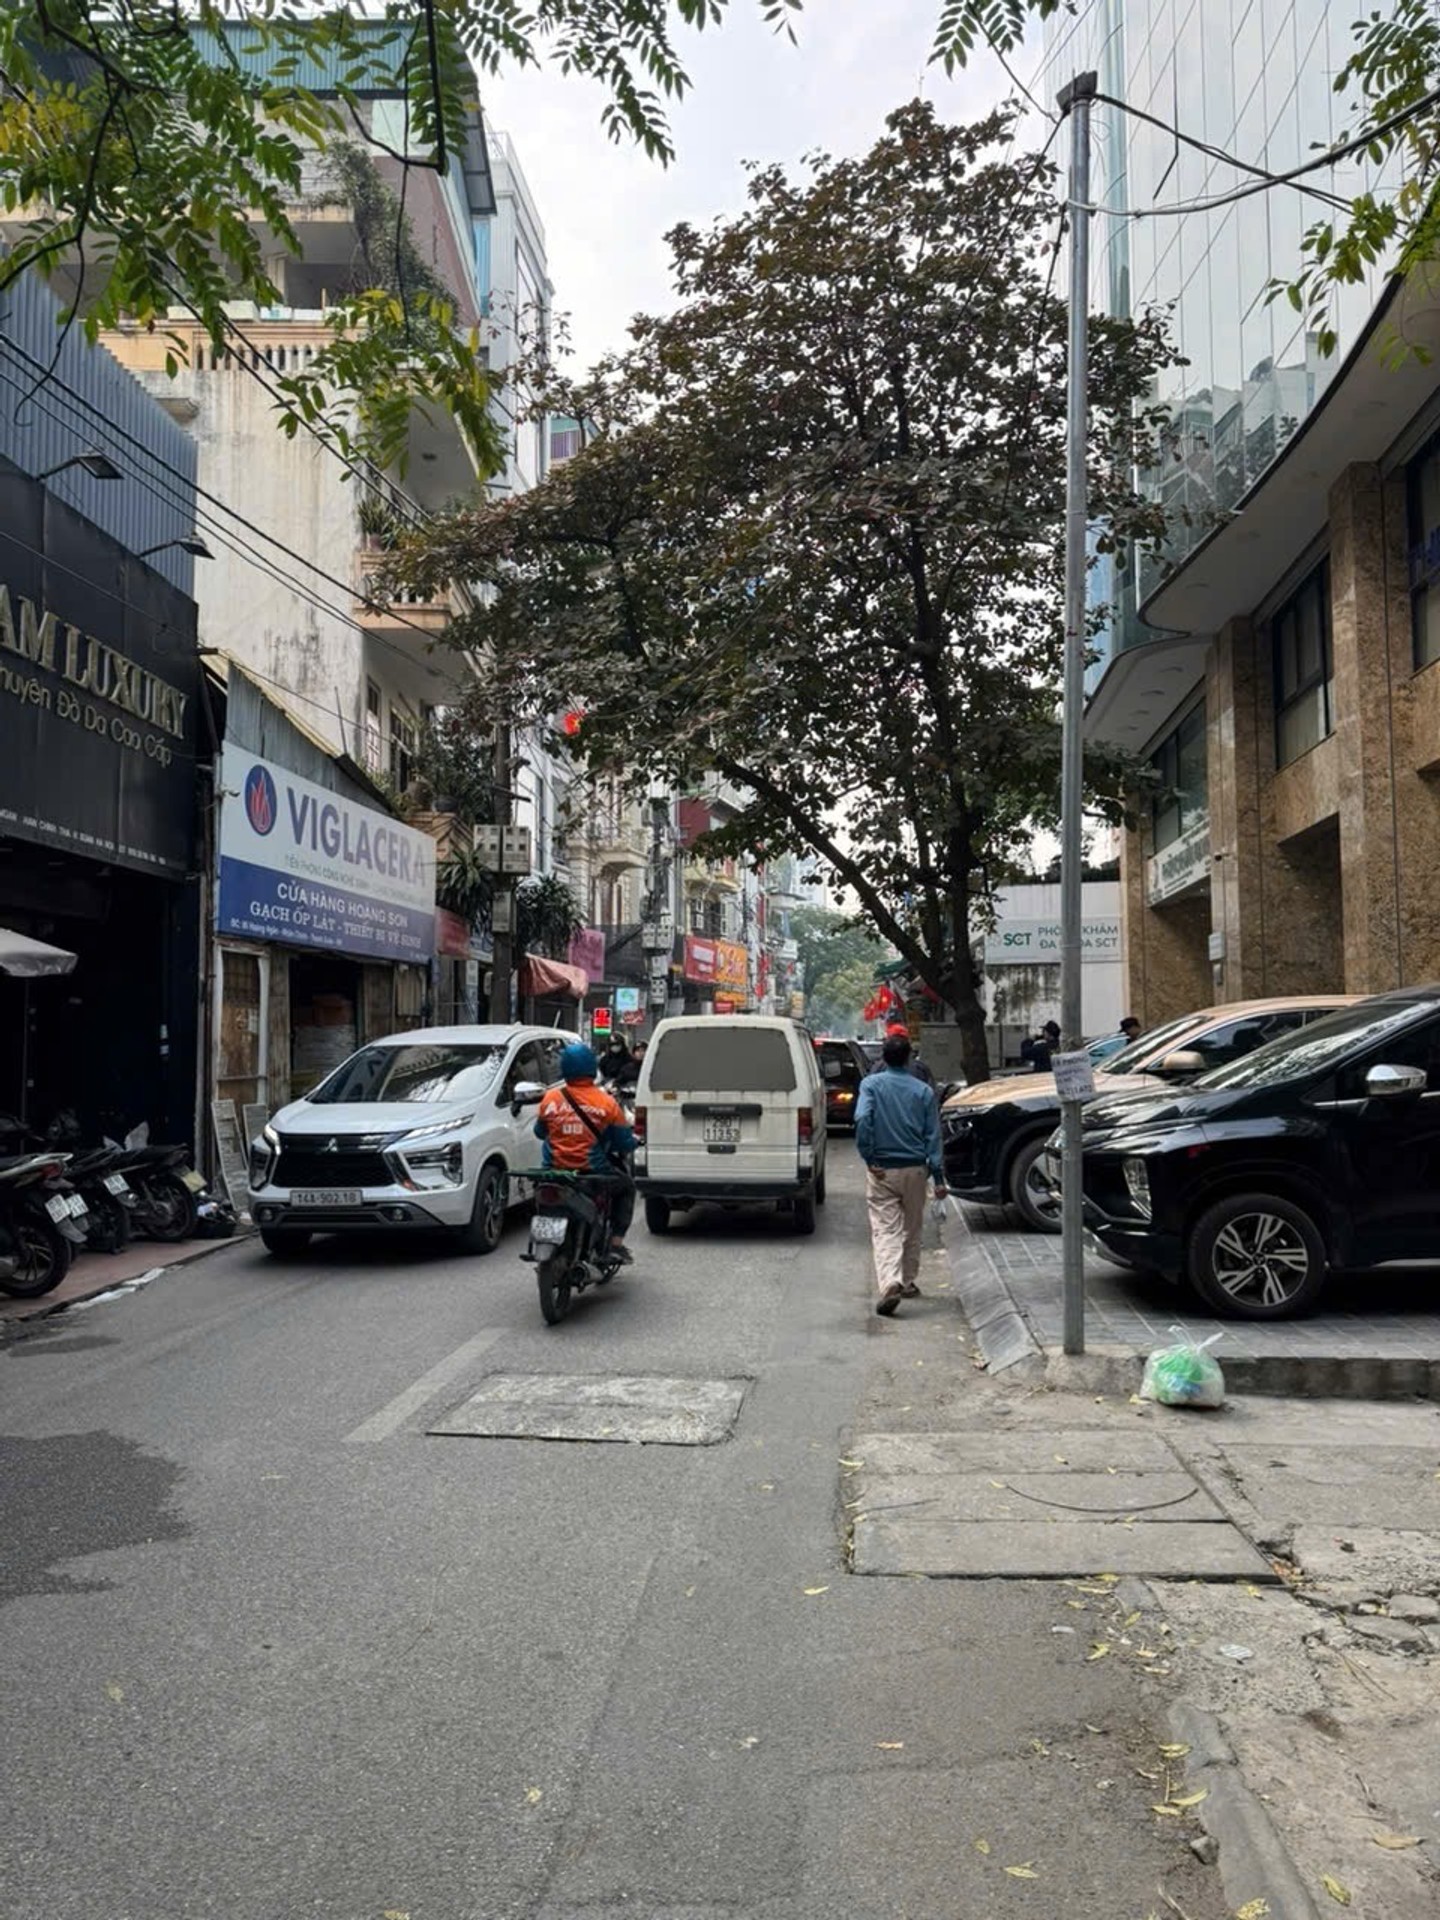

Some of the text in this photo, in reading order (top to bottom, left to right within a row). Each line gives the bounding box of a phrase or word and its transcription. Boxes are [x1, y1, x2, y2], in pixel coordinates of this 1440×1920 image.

[62, 623, 189, 739] LUXURY
[85, 706, 106, 735] Da
[111, 719, 141, 750] Cao
[144, 734, 172, 768] Cấp
[286, 786, 427, 887] VIGLACERA
[277, 880, 308, 905] CỬA
[311, 891, 345, 914] HÀNG
[250, 901, 290, 921] GẠCH
[293, 906, 310, 925] ỐP
[1003, 933, 1032, 946] SCT
[1040, 939, 1057, 949] ĐA
[1095, 937, 1118, 947] SCT
[1082, 923, 1118, 936] KHÁM
